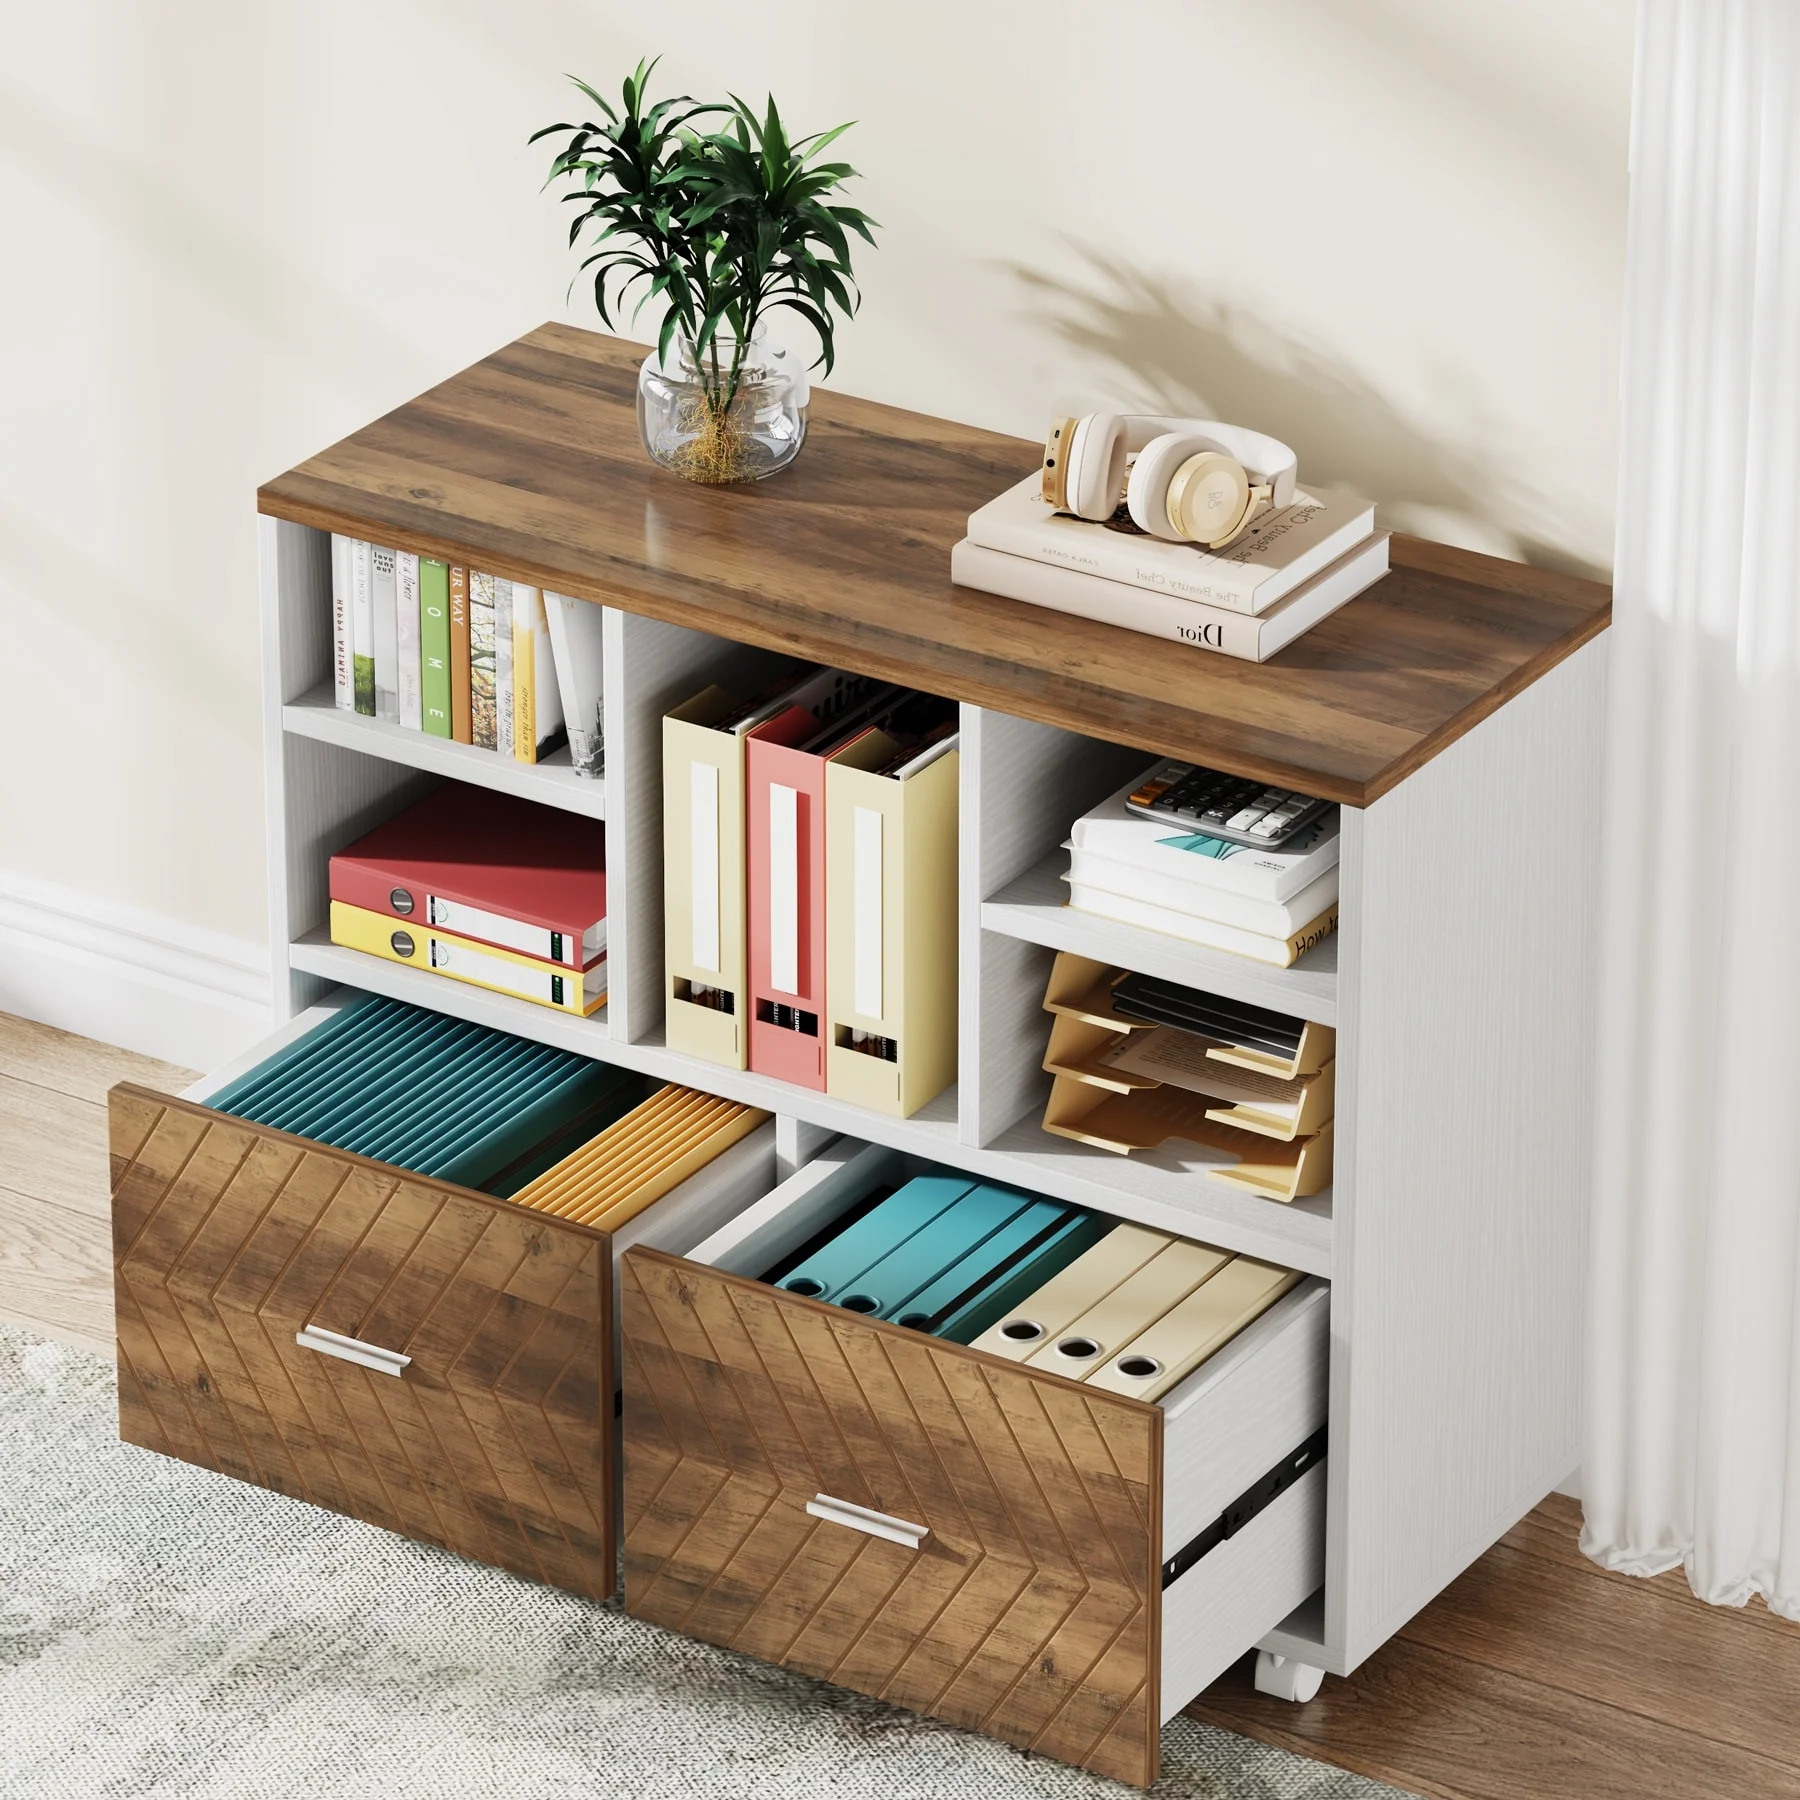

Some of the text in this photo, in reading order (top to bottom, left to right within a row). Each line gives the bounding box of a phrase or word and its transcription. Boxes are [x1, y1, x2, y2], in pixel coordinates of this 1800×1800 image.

[374, 551, 394, 562] love
[373, 559, 395, 569] runs
[376, 565, 392, 574] out
[453, 593, 464, 627] WAY
[1294, 926, 1326, 959] How
